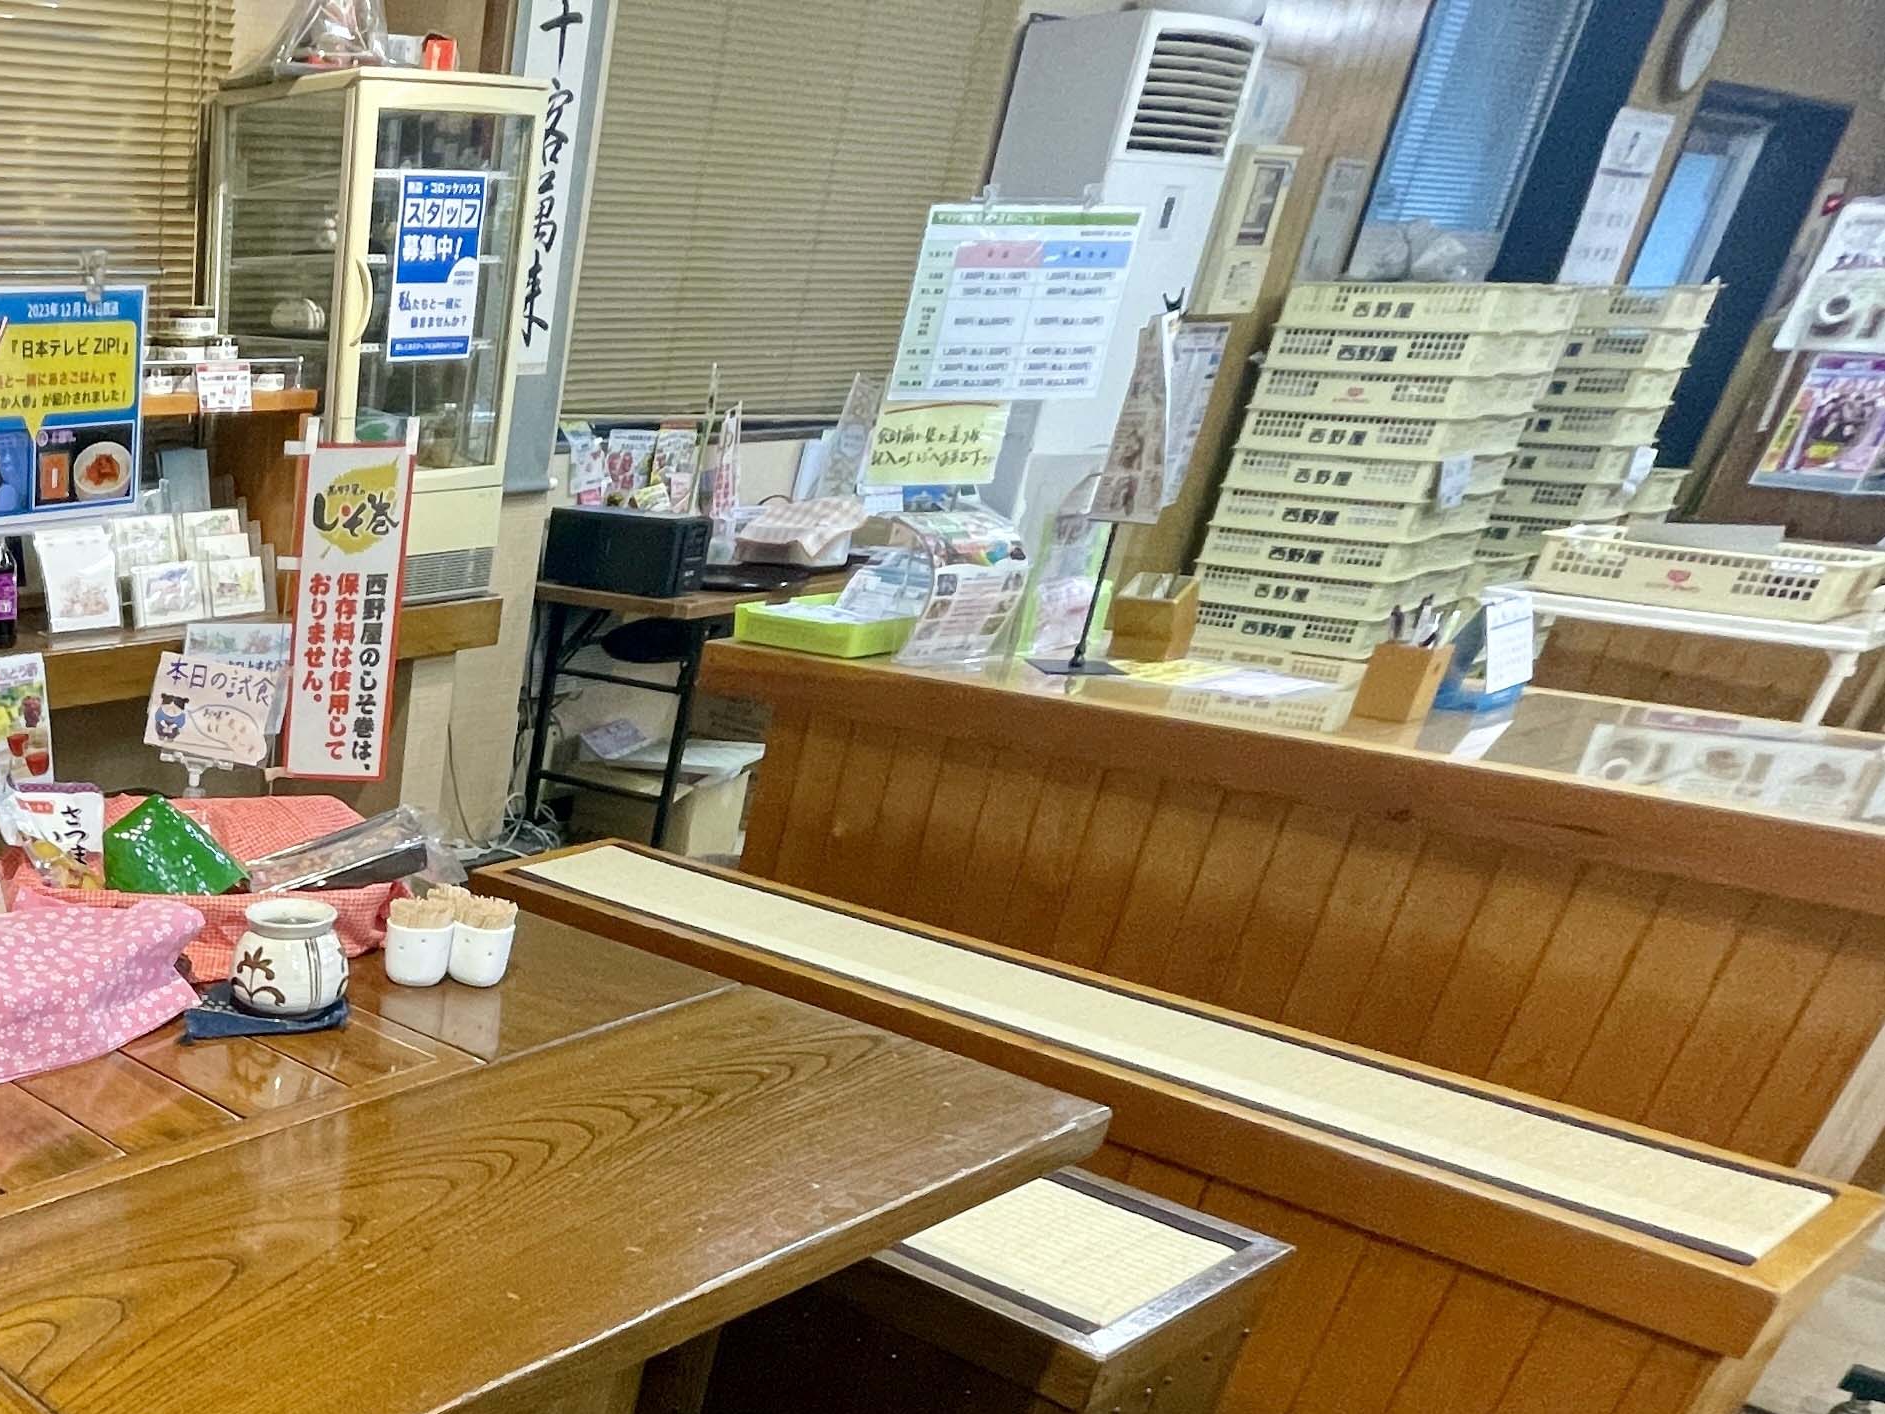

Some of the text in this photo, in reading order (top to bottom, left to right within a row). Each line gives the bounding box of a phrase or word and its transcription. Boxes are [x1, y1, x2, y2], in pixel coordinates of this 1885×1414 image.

[407, 202, 477, 224] スタッフ
[402, 234, 463, 262] 募集中!
[313, 491, 400, 537] しそ巻
[302, 572, 332, 703] おりません。
[166, 656, 277, 707] 本日の試食
[324, 572, 361, 760] 保存料は使用して
